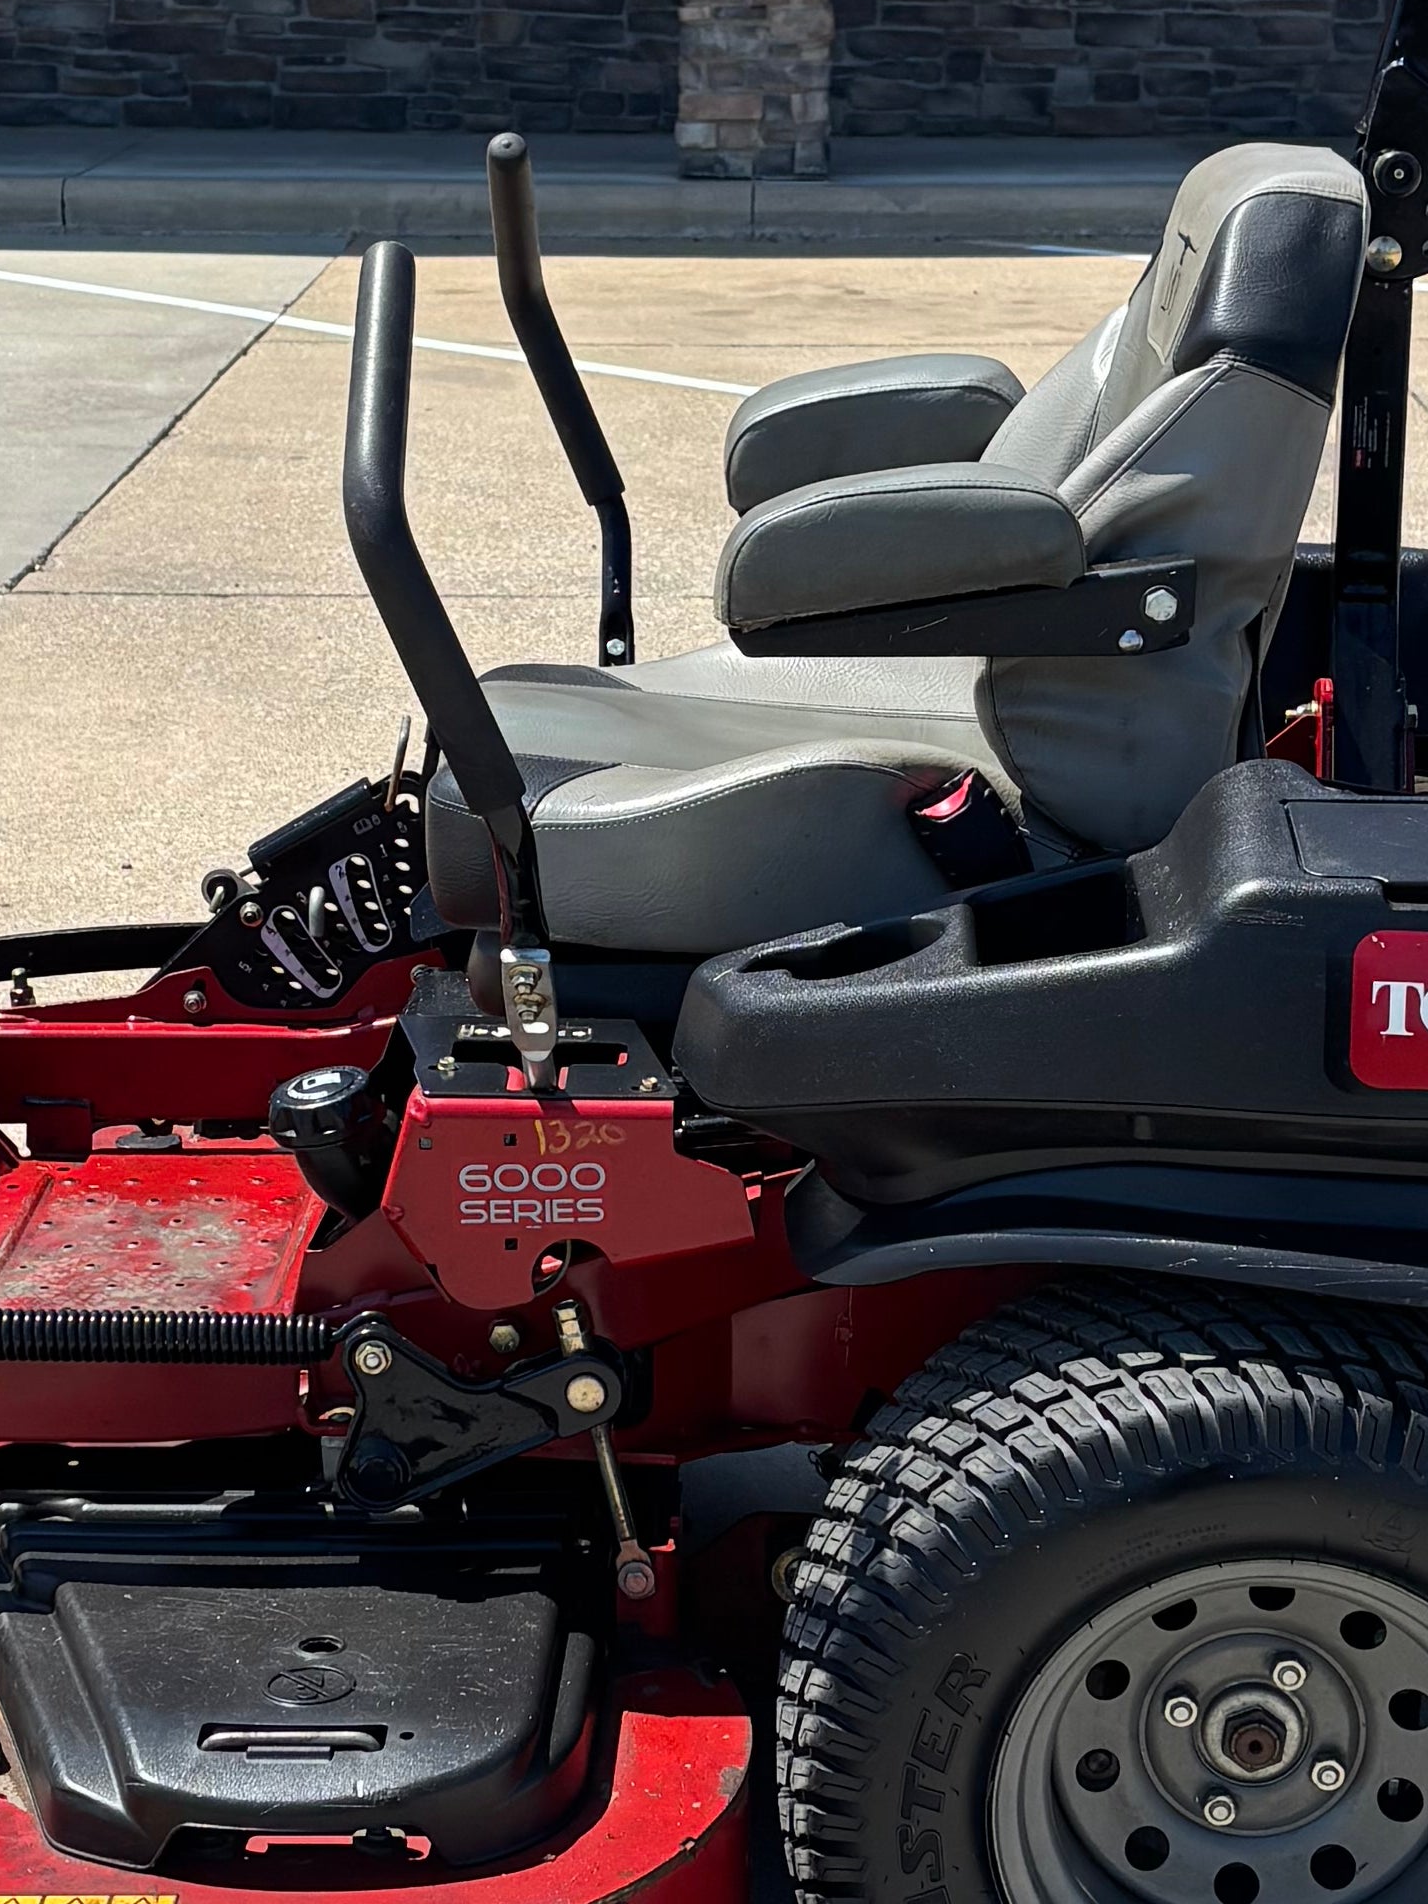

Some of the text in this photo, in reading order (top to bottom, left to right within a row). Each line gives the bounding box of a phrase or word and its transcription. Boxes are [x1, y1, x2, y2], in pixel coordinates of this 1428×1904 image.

[533, 1118, 627, 1156] 1320
[458, 1161, 607, 1194] 6000
[459, 1197, 606, 1226] SERIES
